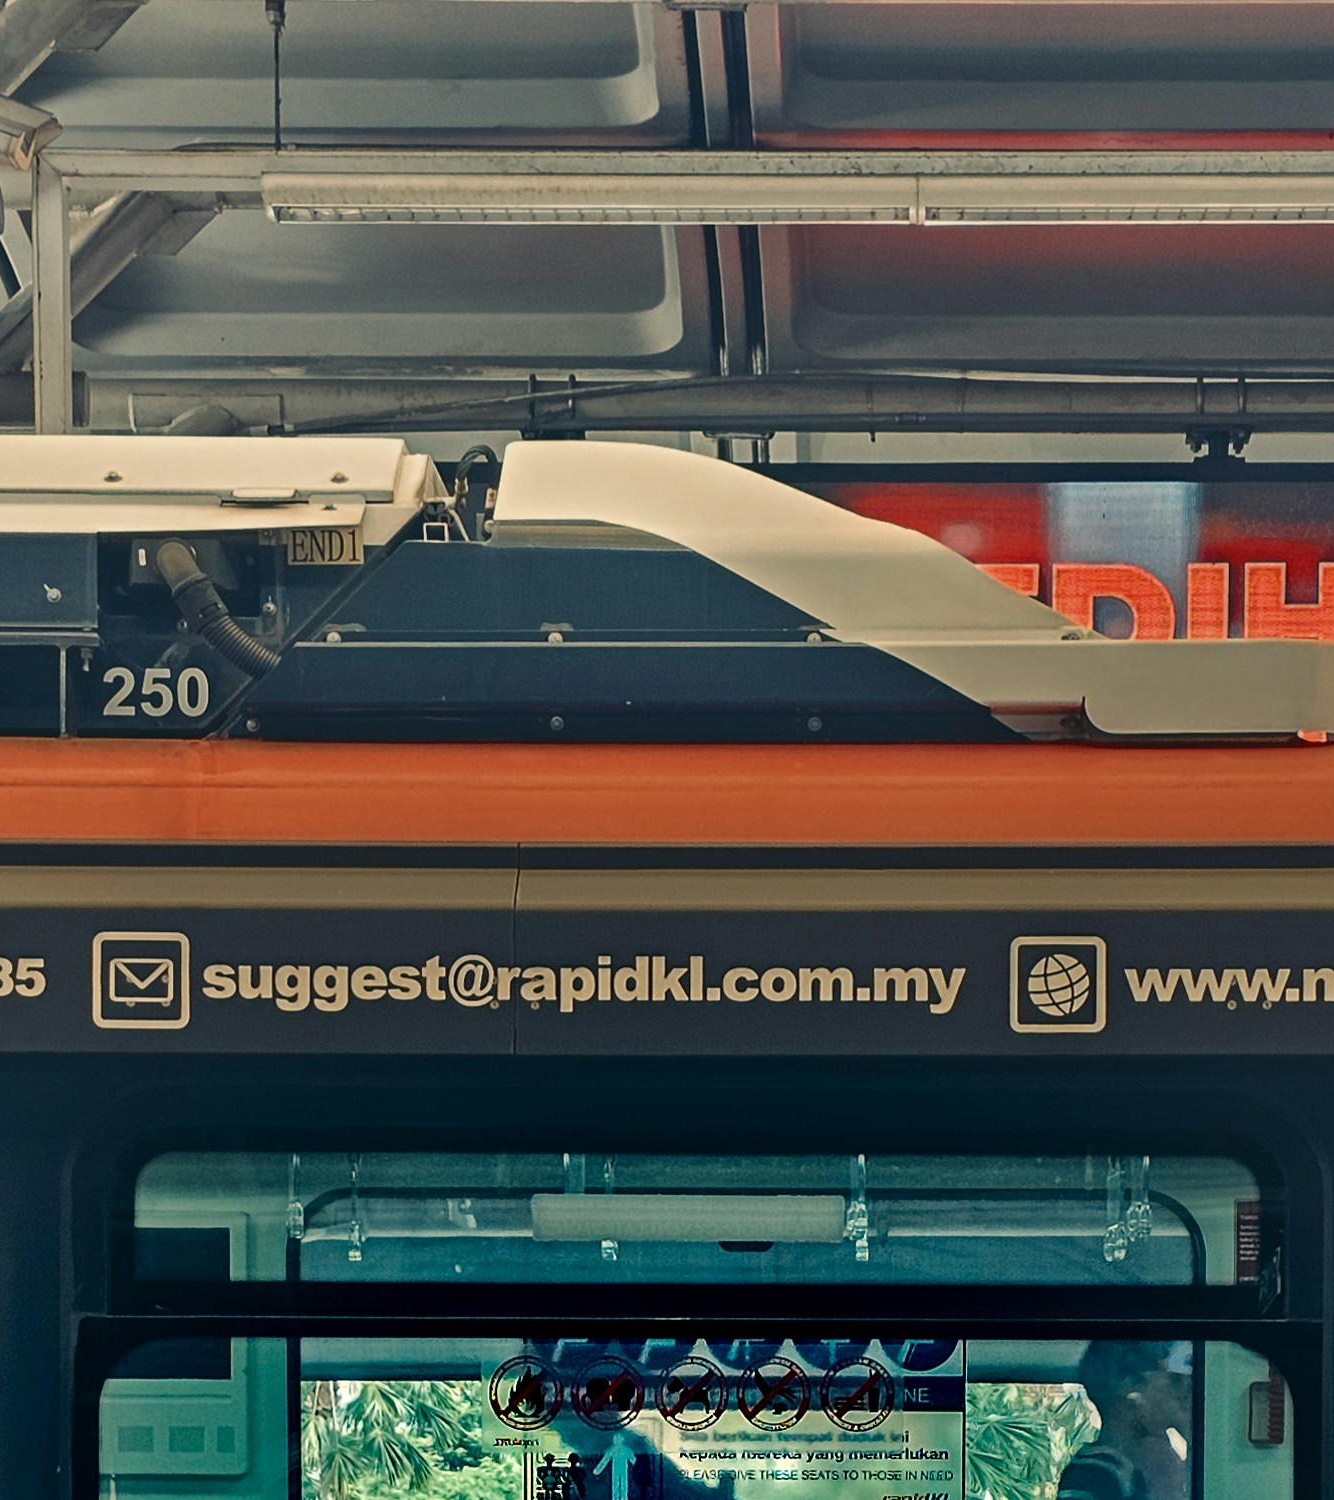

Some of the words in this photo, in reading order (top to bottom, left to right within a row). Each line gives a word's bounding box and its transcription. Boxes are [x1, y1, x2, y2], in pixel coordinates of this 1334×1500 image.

[291, 528, 361, 564] END1
[102, 667, 209, 717] 250
[202, 954, 966, 1015] suggest@rapidkl.com.my
[805, 1449, 844, 1464] yang
[759, 1469, 799, 1482] THESE
[801, 1469, 840, 1482] SEATS
[842, 1469, 860, 1482] TO
[861, 1469, 903, 1482] THOSE
[905, 1469, 918, 1482] IN
[920, 1469, 955, 1482] NEED
